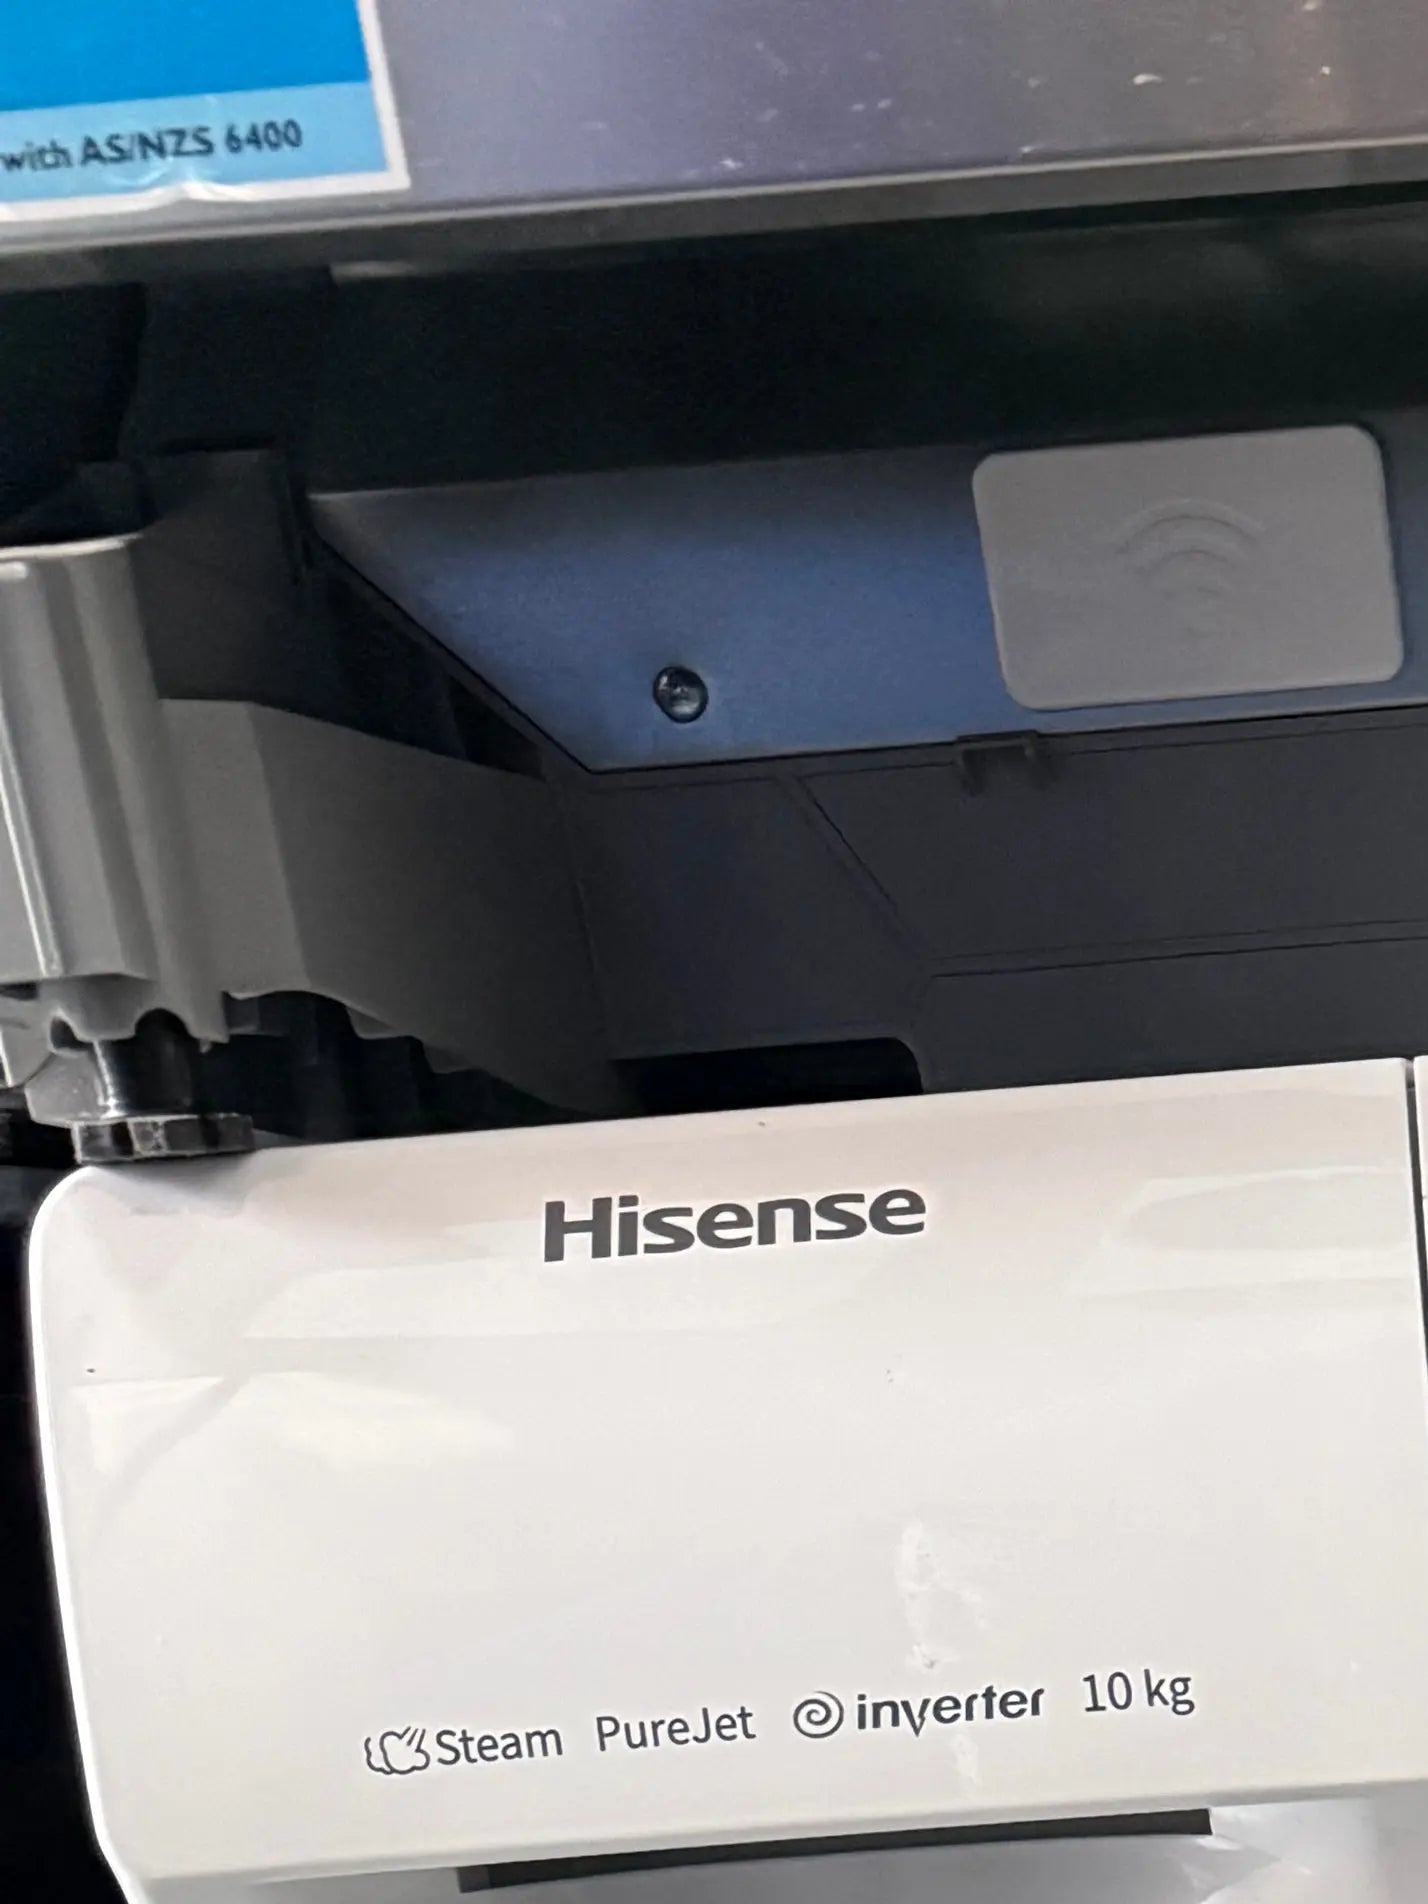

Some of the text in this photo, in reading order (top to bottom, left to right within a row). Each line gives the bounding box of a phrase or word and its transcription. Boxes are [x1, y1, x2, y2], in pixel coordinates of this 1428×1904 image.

[0, 120, 302, 171] with AS/NZS 6400
[543, 1188, 926, 1262] Hisense
[436, 1669, 1196, 1765] Steam PureJet inverter 10 kg
